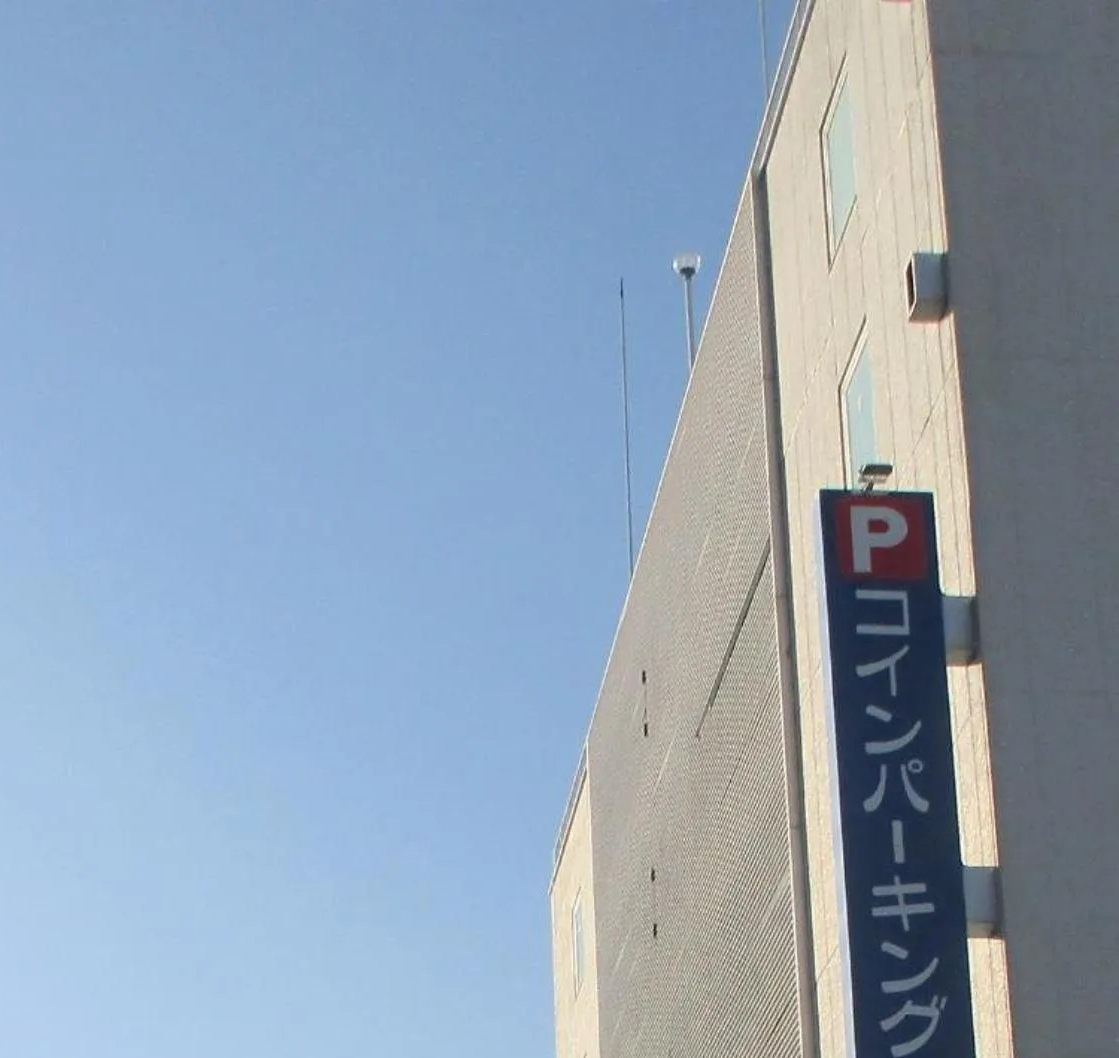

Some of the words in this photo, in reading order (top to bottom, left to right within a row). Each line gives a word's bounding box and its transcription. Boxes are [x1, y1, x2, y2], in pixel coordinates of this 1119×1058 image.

[849, 506, 909, 574] P
[855, 590, 948, 1058] コインパーキング
